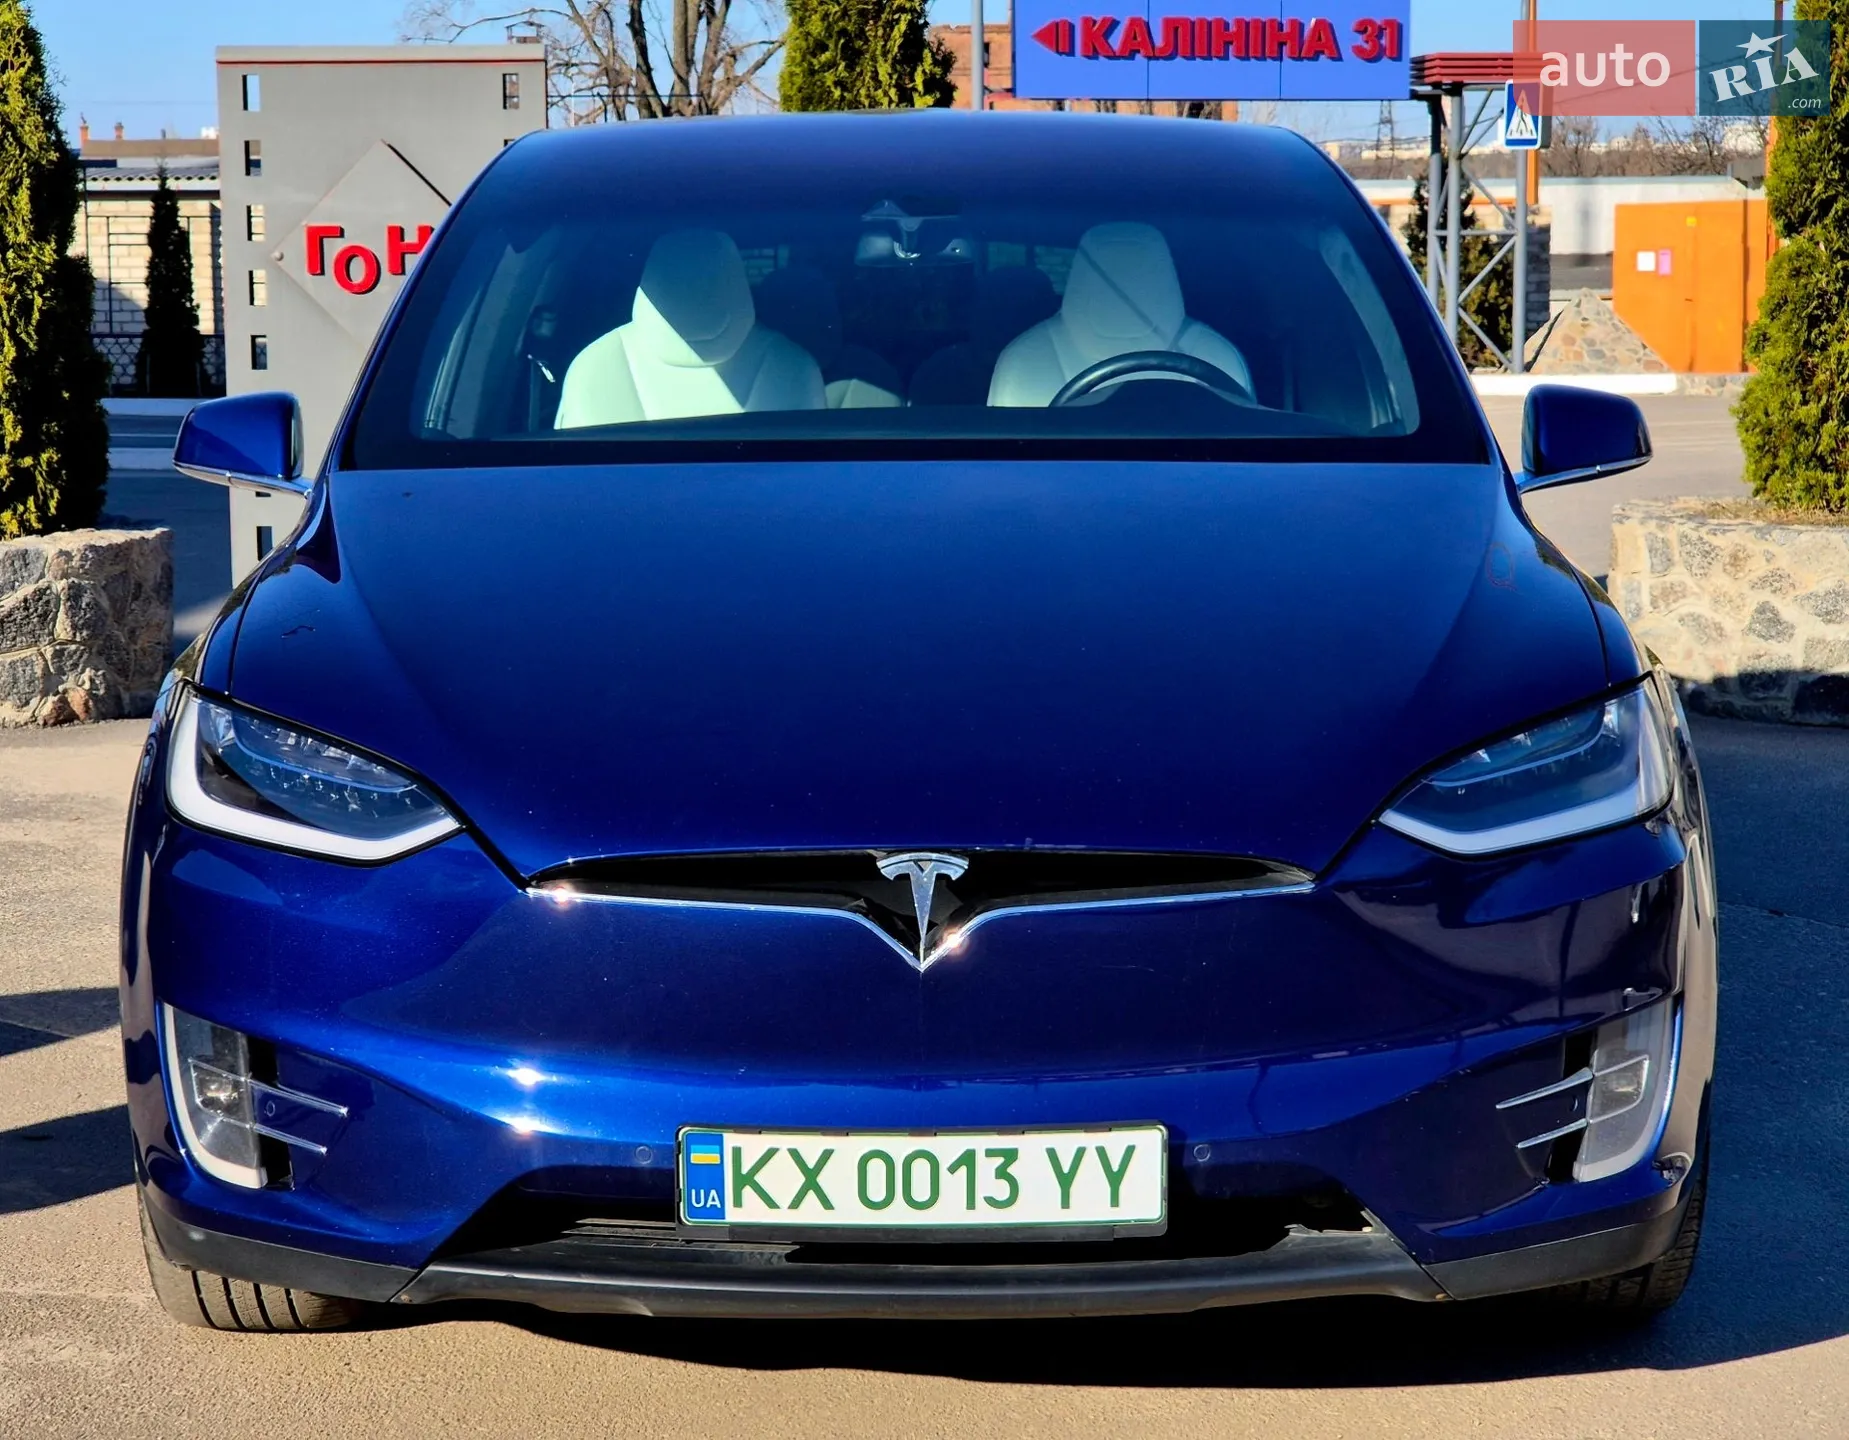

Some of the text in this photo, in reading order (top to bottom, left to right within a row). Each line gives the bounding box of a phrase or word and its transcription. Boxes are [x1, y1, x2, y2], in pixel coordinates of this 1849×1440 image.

[1079, 16, 1400, 60] КАЛІНІНА 31
[691, 1188, 721, 1208] UA
[732, 1144, 1136, 1210] KX 0013 YY
